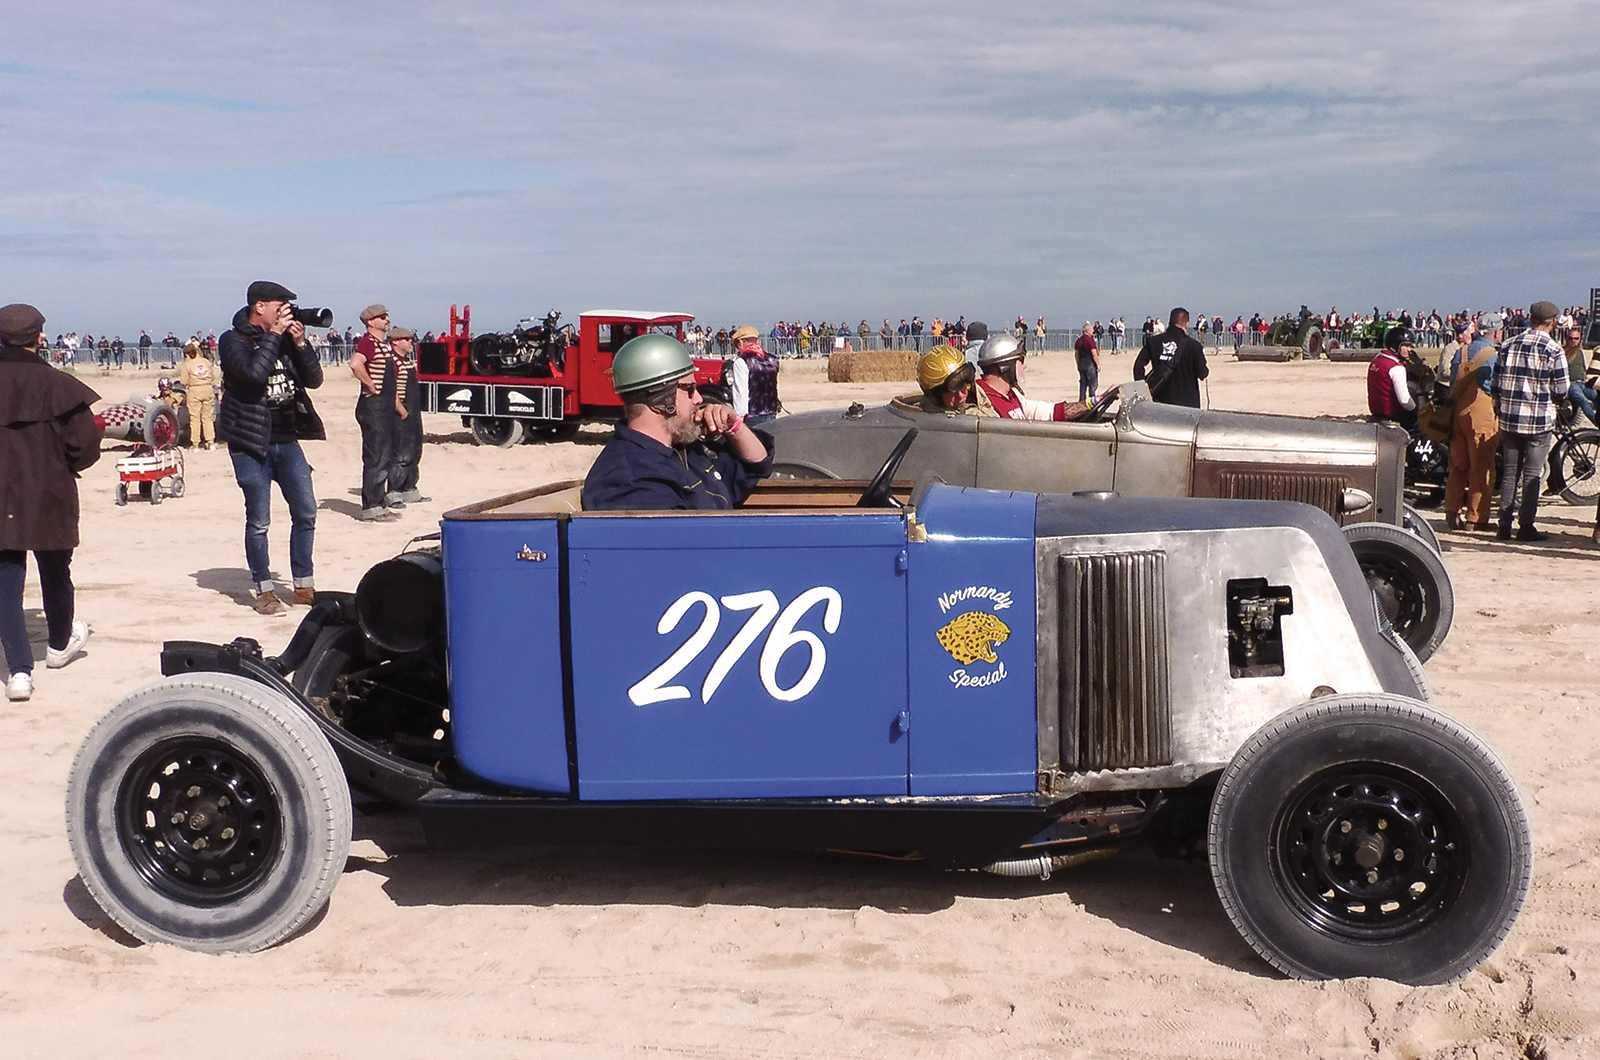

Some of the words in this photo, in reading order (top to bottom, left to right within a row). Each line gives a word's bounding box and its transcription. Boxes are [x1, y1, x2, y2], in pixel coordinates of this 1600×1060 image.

[1414, 439, 1434, 455] 44
[1421, 453, 1429, 462] A
[937, 586, 1014, 614] Normandy
[626, 585, 843, 707] 276
[948, 661, 1008, 689] Special
